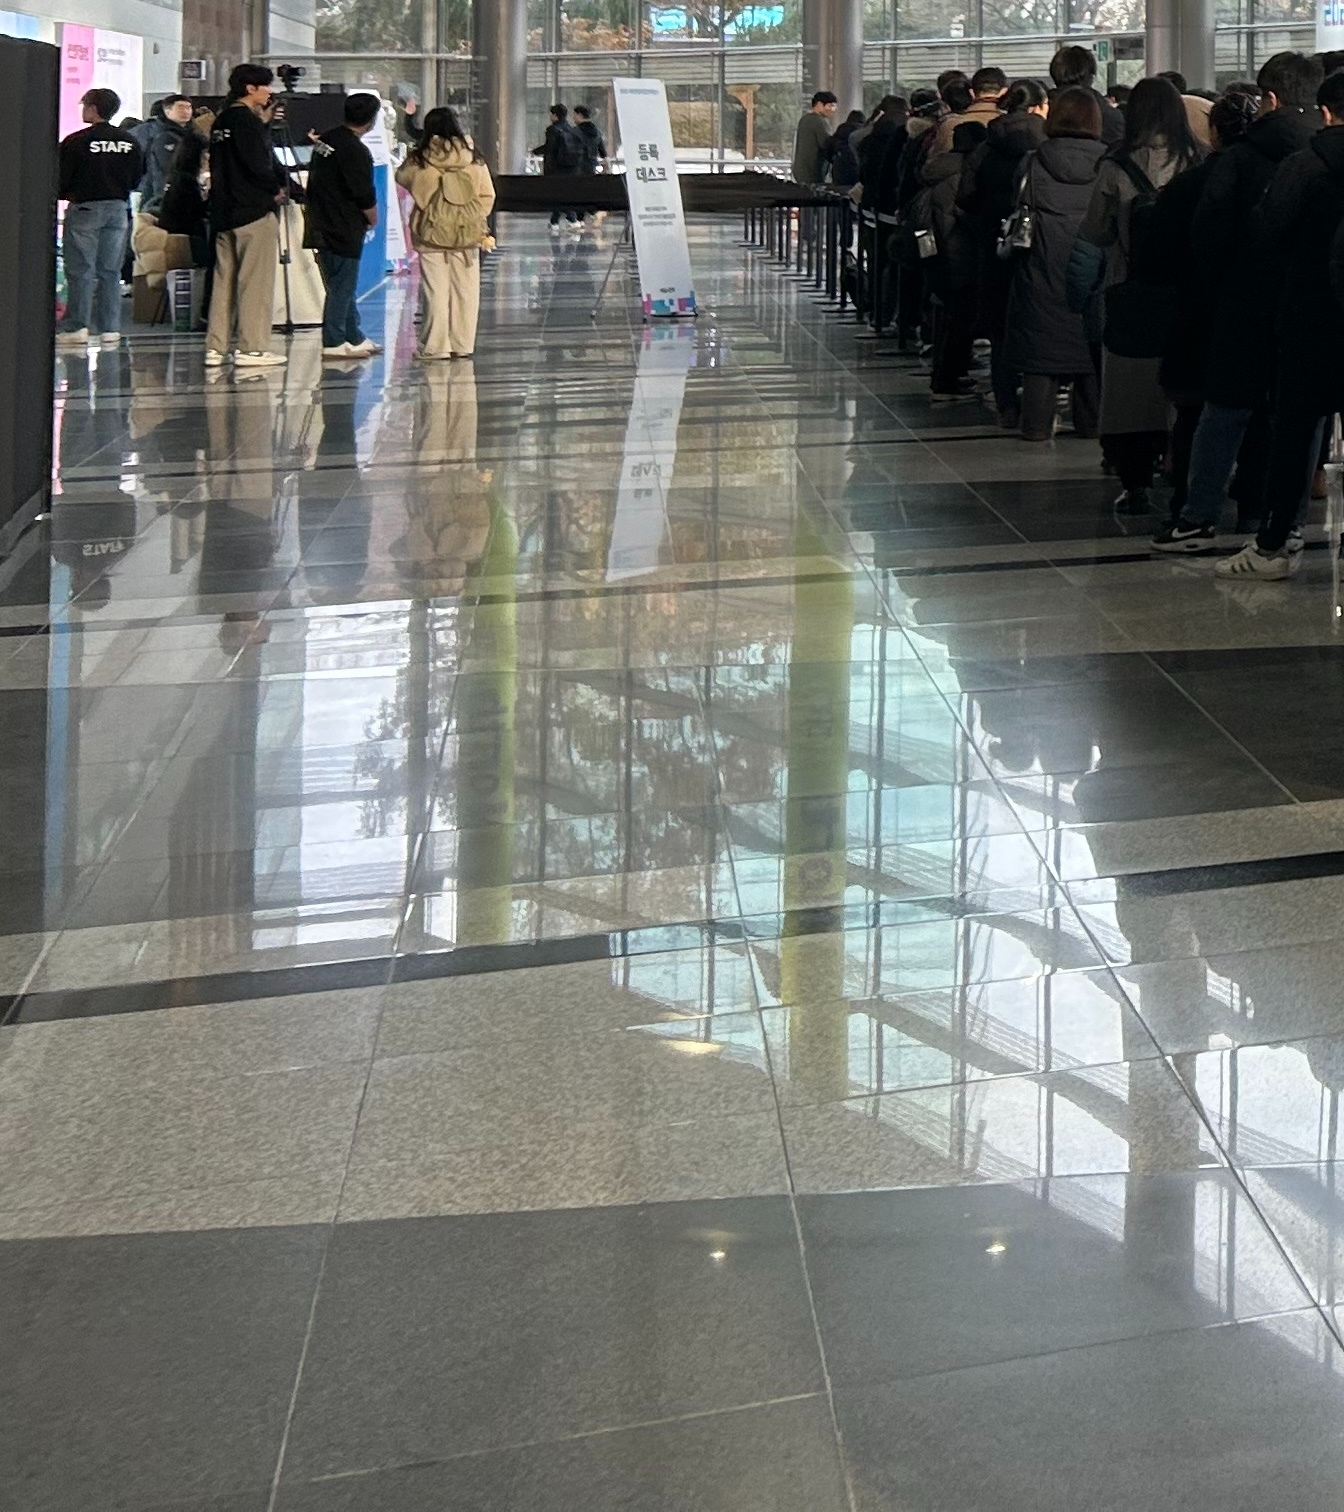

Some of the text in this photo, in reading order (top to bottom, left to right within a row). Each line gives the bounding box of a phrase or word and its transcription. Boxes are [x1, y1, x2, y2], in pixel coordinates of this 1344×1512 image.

[89, 140, 134, 153] STAFF
[637, 143, 660, 161] 등록
[635, 167, 668, 183] 데스크
